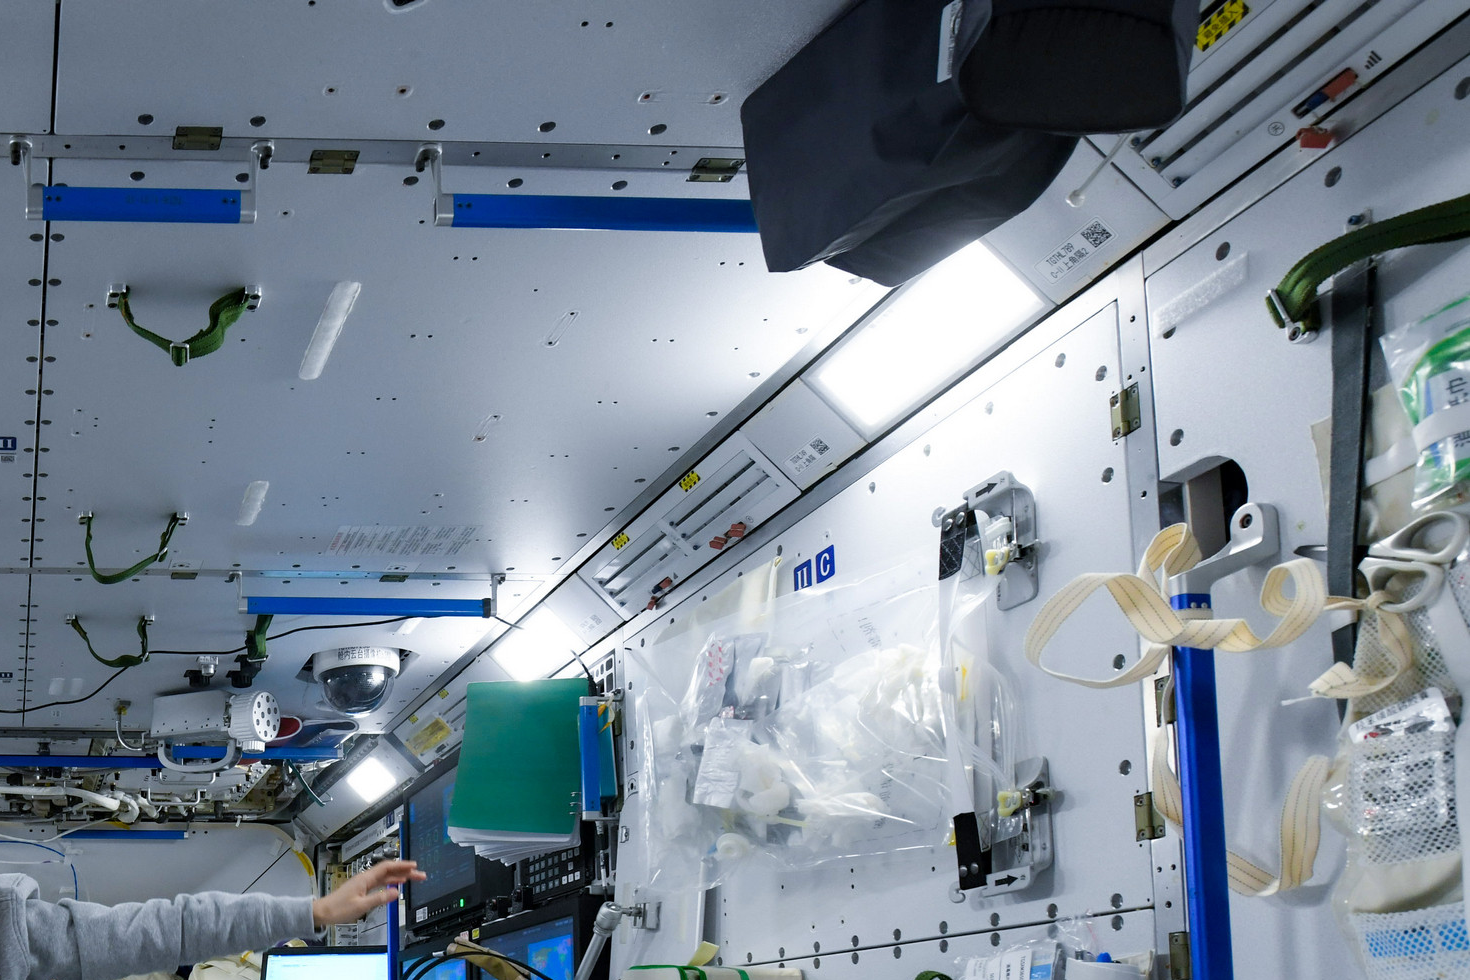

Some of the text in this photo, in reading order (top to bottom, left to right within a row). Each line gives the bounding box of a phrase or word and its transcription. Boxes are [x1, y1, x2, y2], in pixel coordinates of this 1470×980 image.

[1046, 242, 1074, 268] TGTHL789
[797, 553, 830, 590] II C
